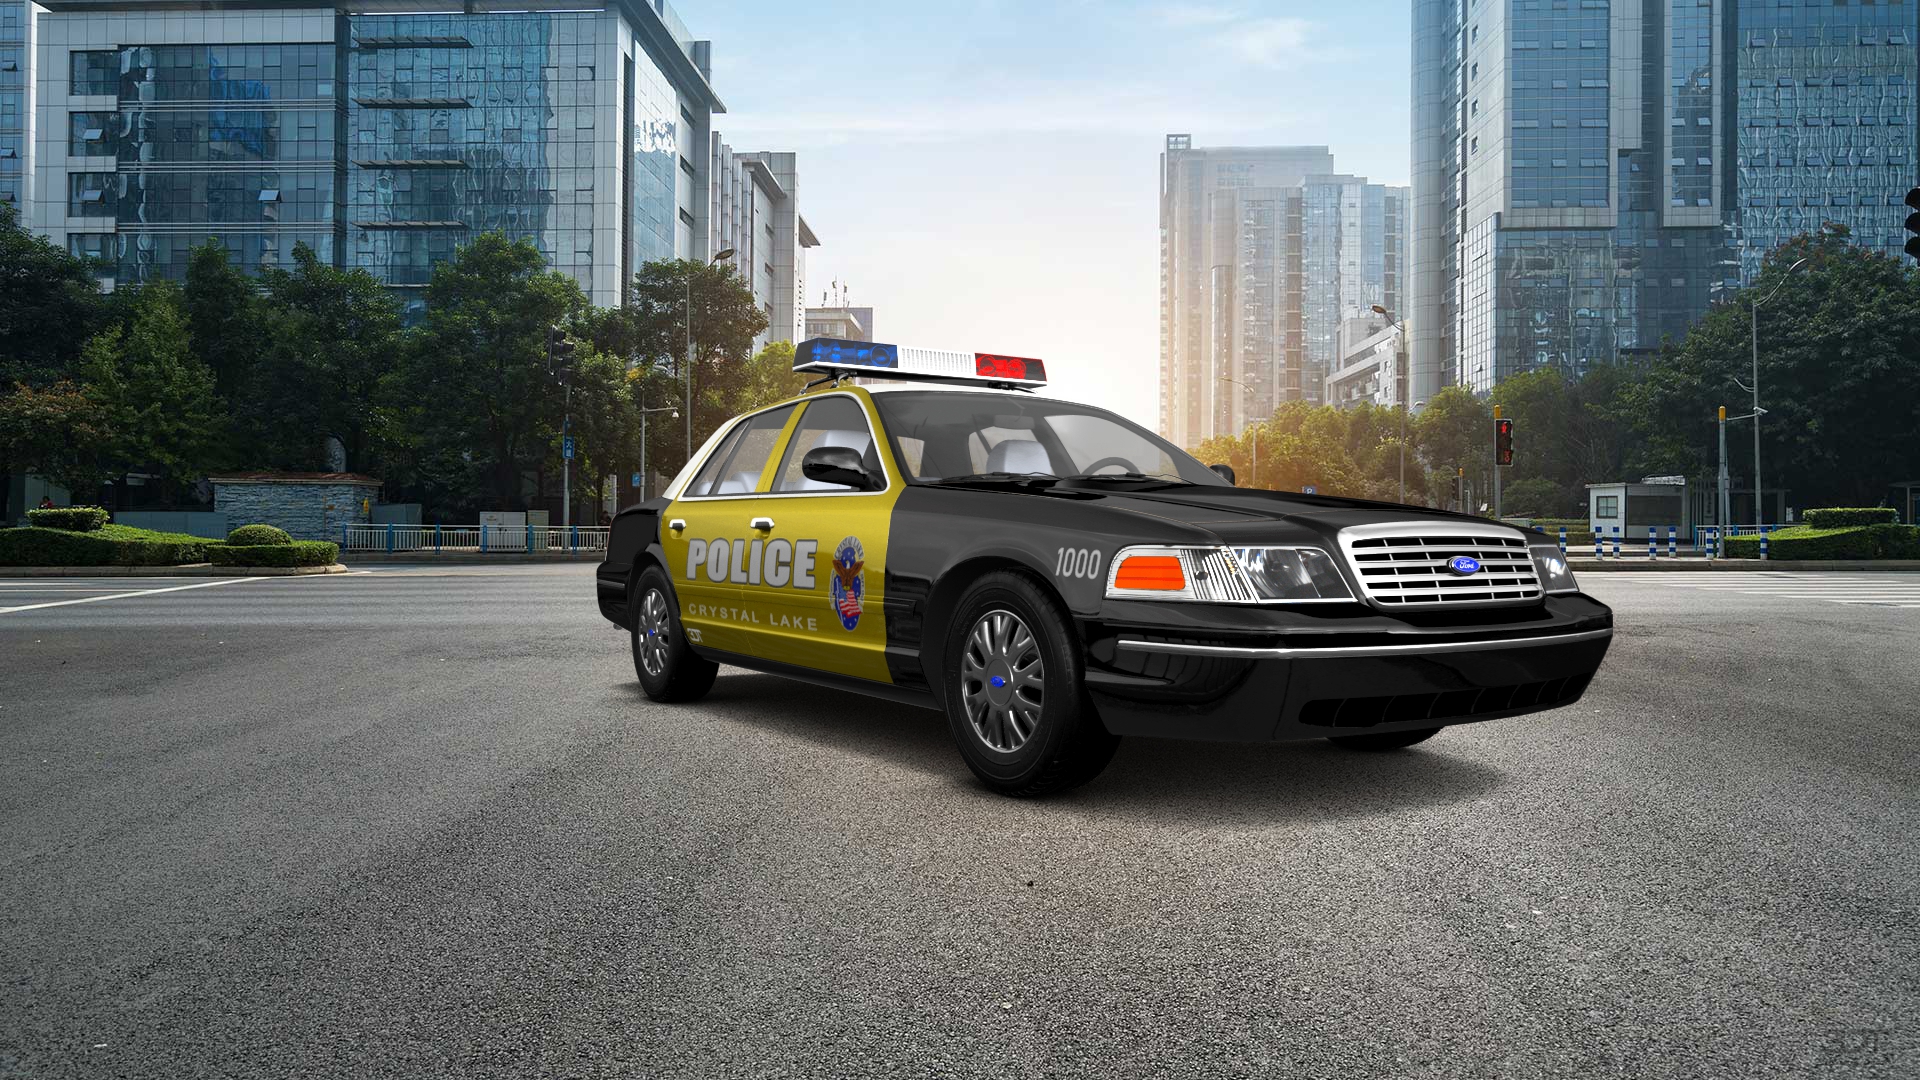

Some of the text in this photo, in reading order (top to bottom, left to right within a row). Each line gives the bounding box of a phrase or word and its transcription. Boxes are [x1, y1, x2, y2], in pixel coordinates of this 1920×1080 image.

[686, 538, 818, 590] POLICE
[1055, 547, 1101, 580] 1000
[1459, 560, 1475, 569] Ford
[688, 603, 818, 632] CRYSTAL LAKE
